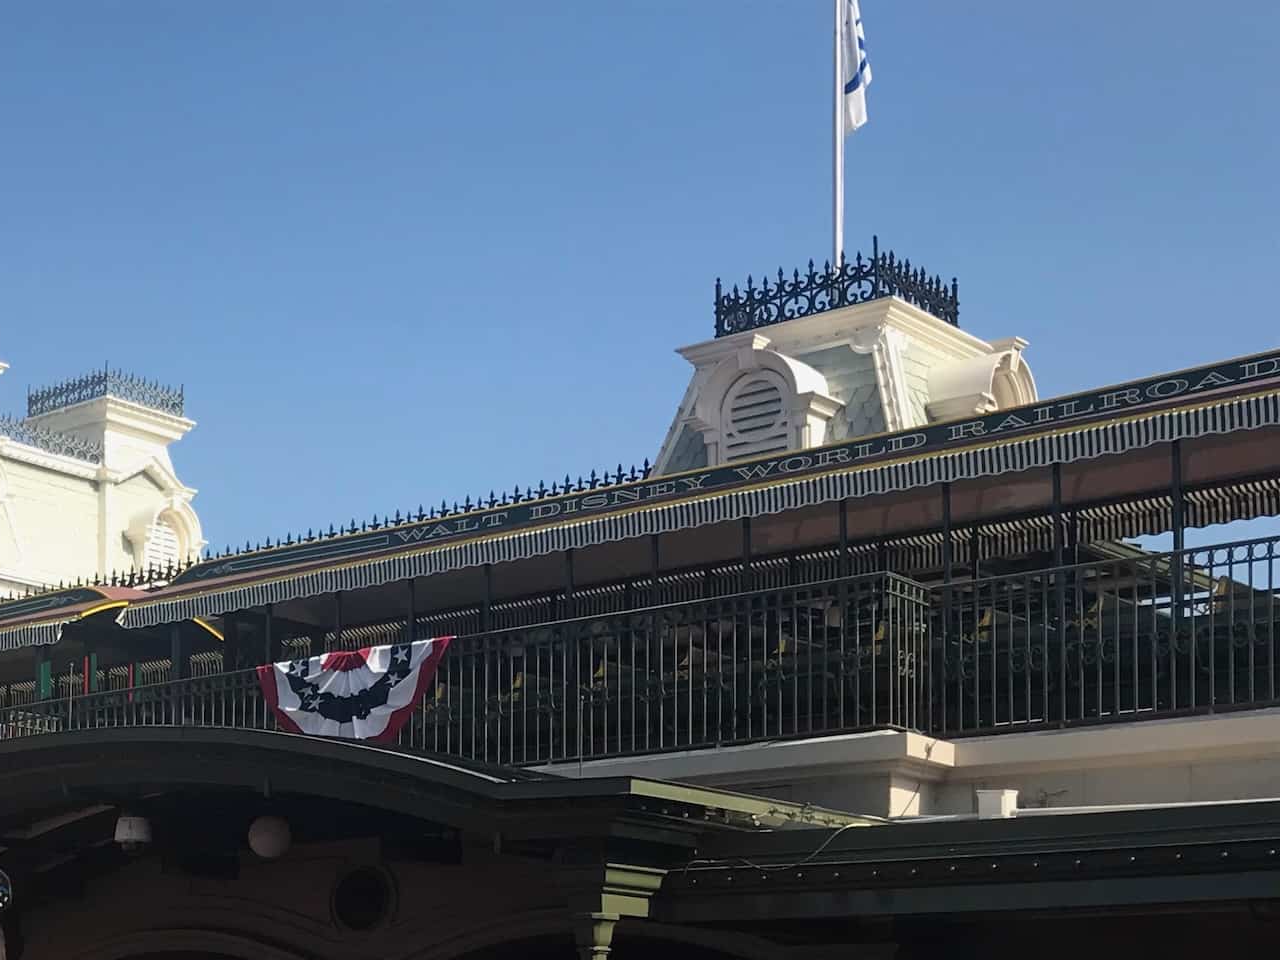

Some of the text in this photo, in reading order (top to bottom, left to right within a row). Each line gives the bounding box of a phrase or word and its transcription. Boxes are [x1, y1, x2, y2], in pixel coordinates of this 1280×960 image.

[393, 358, 1280, 542] WALT DISNEY WORLD RAILROAD
